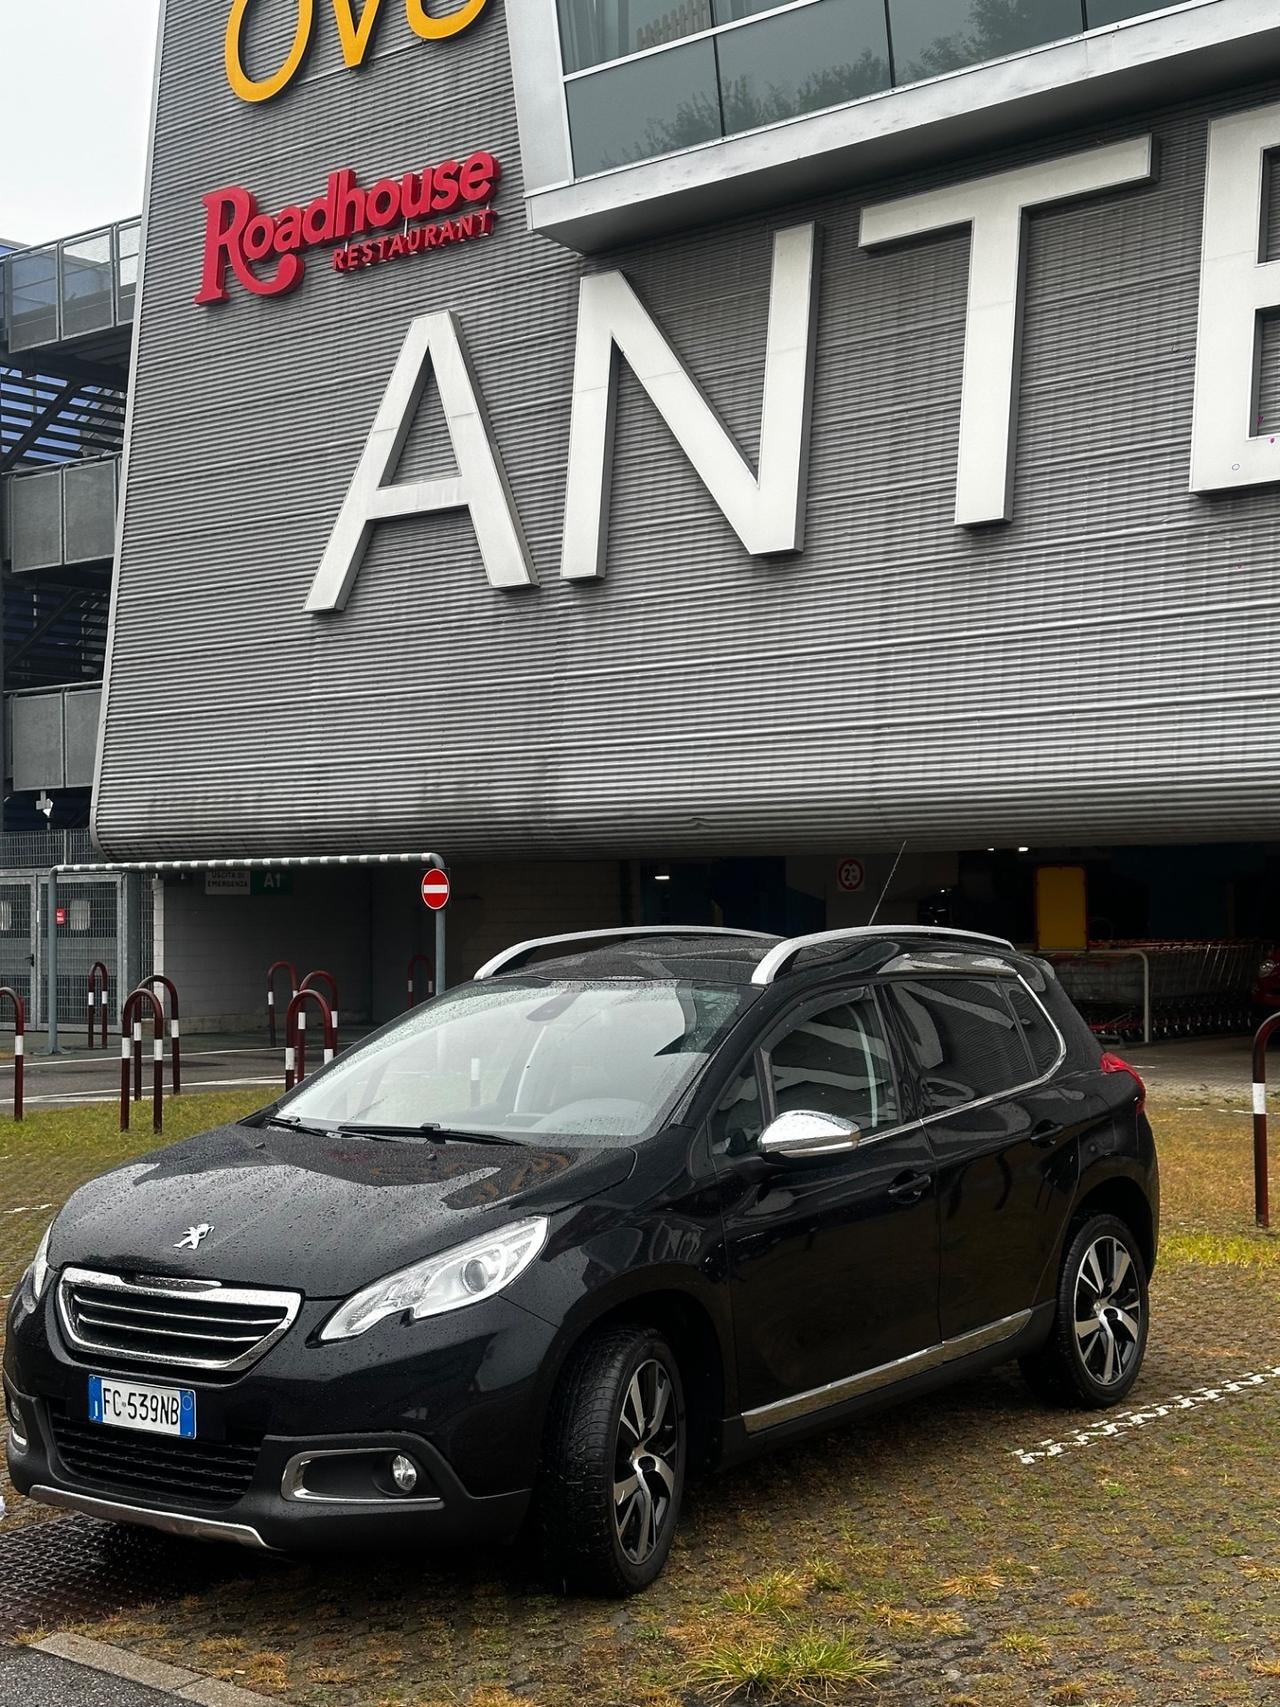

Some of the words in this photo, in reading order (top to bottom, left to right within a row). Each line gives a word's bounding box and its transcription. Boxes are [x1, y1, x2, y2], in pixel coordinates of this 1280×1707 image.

[195, 151, 499, 305] Roadhouse
[331, 210, 497, 273] RESTAURANT
[263, 872, 281, 888] A1
